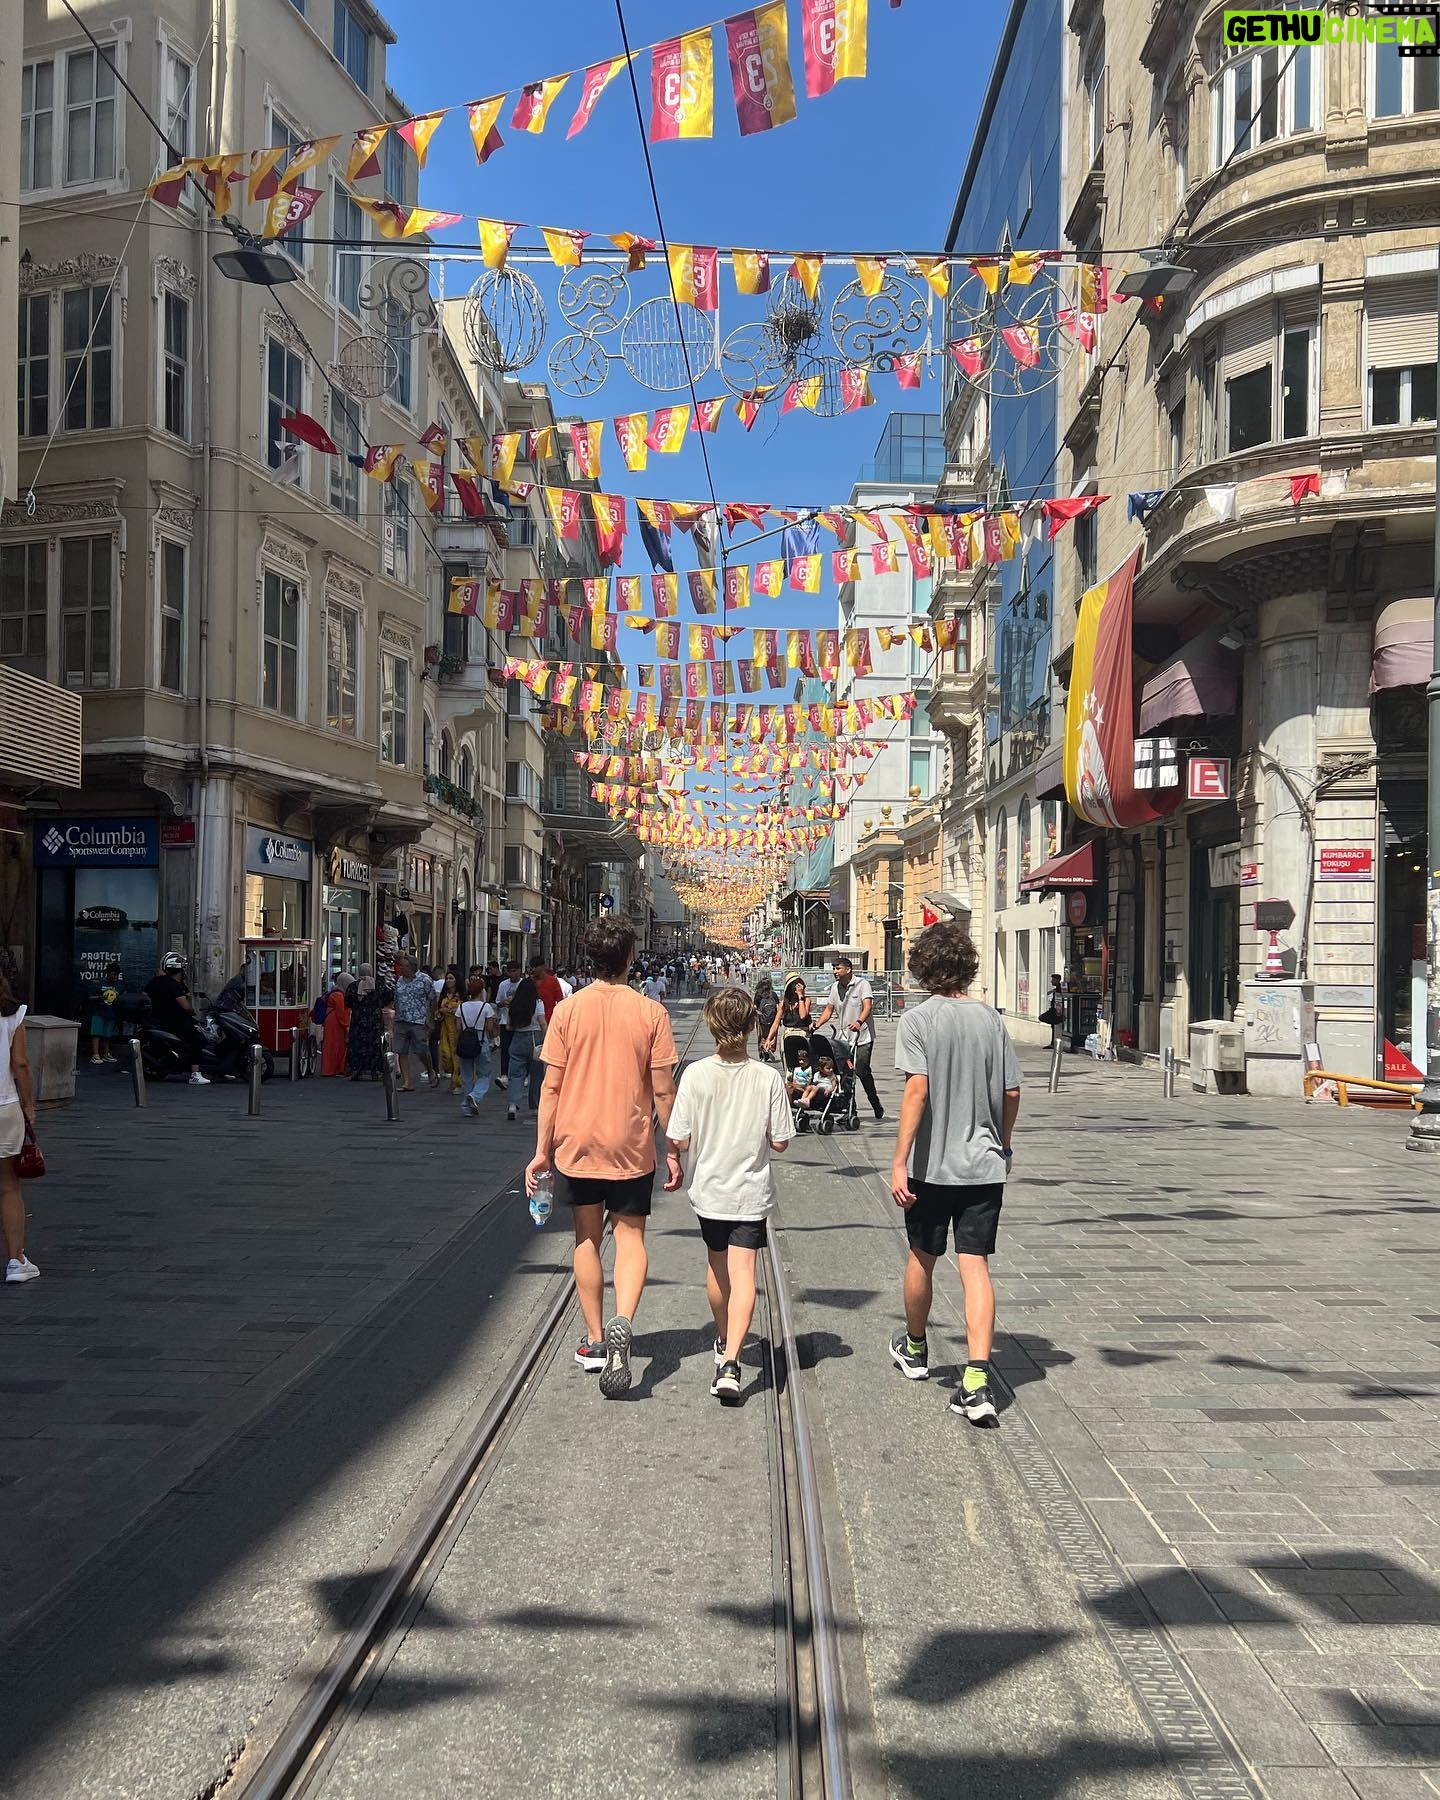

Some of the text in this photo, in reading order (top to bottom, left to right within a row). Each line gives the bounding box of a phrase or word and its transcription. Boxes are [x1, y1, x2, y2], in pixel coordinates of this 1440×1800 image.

[65, 826, 146, 845] Columbia
[69, 847, 147, 858] Sportswear Company
[274, 839, 302, 861] Columbia
[1322, 851, 1364, 859] KUMBARACI
[90, 911, 120, 919] Columbia
[80, 951, 122, 962] PROTECT
[1384, 1063, 1407, 1071] SALE
